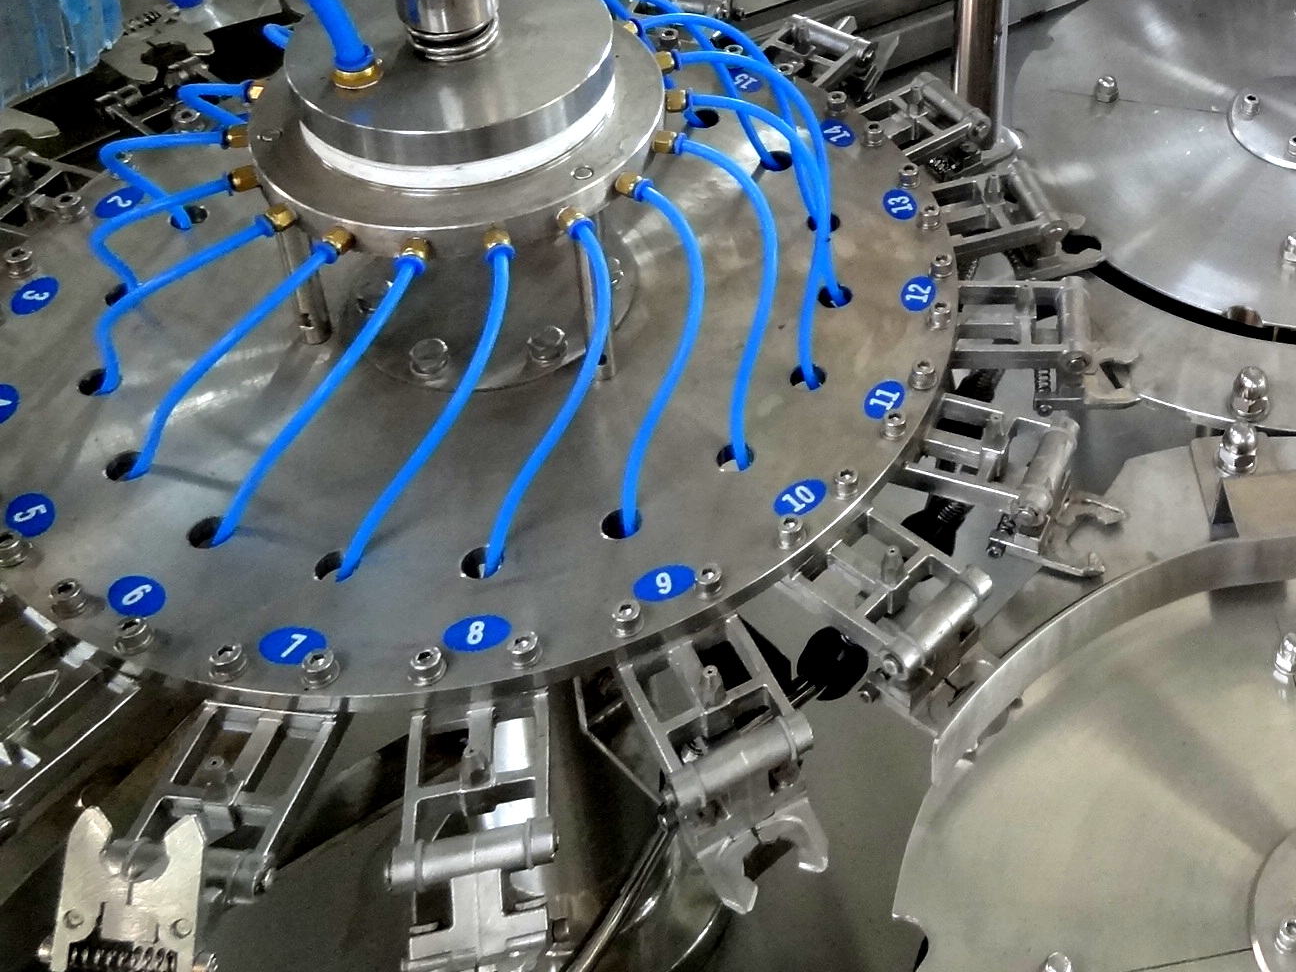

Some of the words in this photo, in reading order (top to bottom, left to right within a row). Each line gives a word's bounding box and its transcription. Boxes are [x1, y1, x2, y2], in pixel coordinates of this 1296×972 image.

[733, 73, 758, 90] 15
[823, 125, 851, 143] 14
[106, 195, 133, 208] 2
[887, 195, 914, 214] 13
[22, 289, 50, 301] 3
[905, 283, 932, 303] 12
[869, 388, 901, 410] 11
[781, 485, 816, 512] 10
[13, 504, 48, 523] 5
[655, 572, 672, 595] 9
[122, 584, 153, 606] 6
[466, 620, 486, 645] 8
[280, 633, 308, 658] 7
